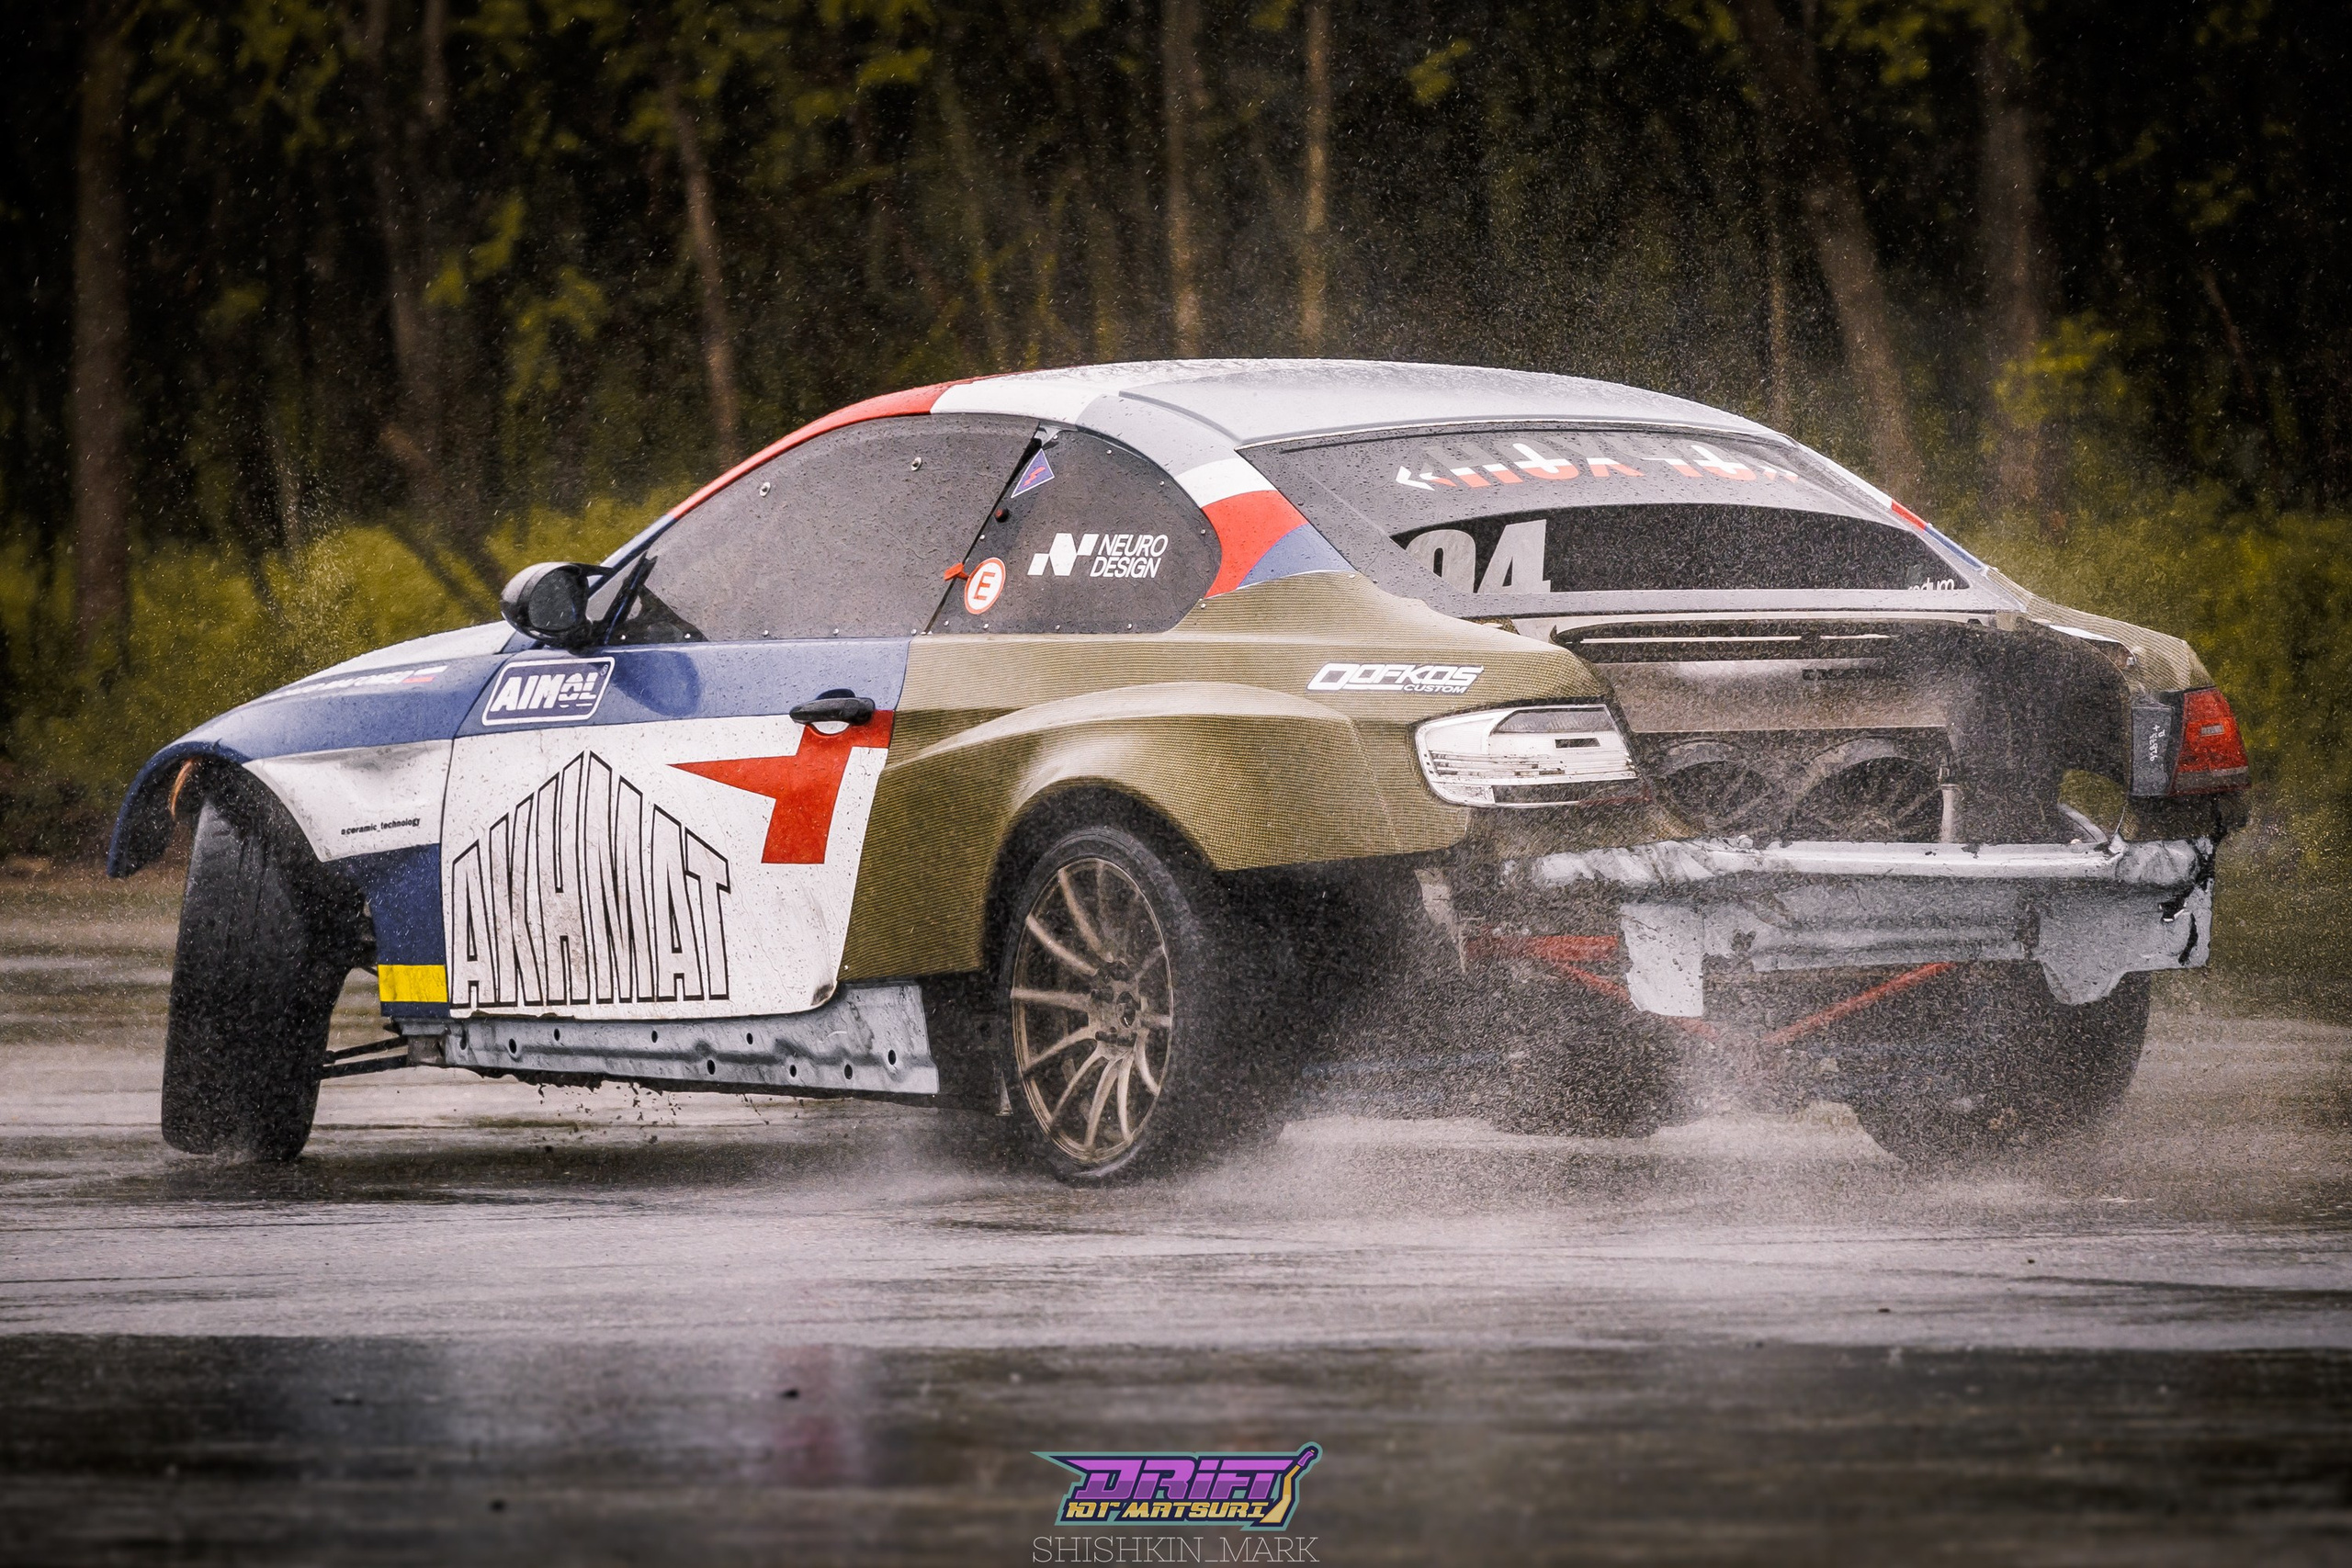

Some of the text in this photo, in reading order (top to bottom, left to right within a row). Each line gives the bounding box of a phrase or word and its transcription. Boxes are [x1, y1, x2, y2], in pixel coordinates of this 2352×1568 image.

[1099, 534, 1169, 558] NEURO
[1090, 556, 1161, 579] DESIGN
[973, 571, 996, 601] E
[490, 671, 599, 713] AIMOL
[1403, 683, 1468, 694] CUSTOM
[449, 750, 730, 1009] AKHMAT
